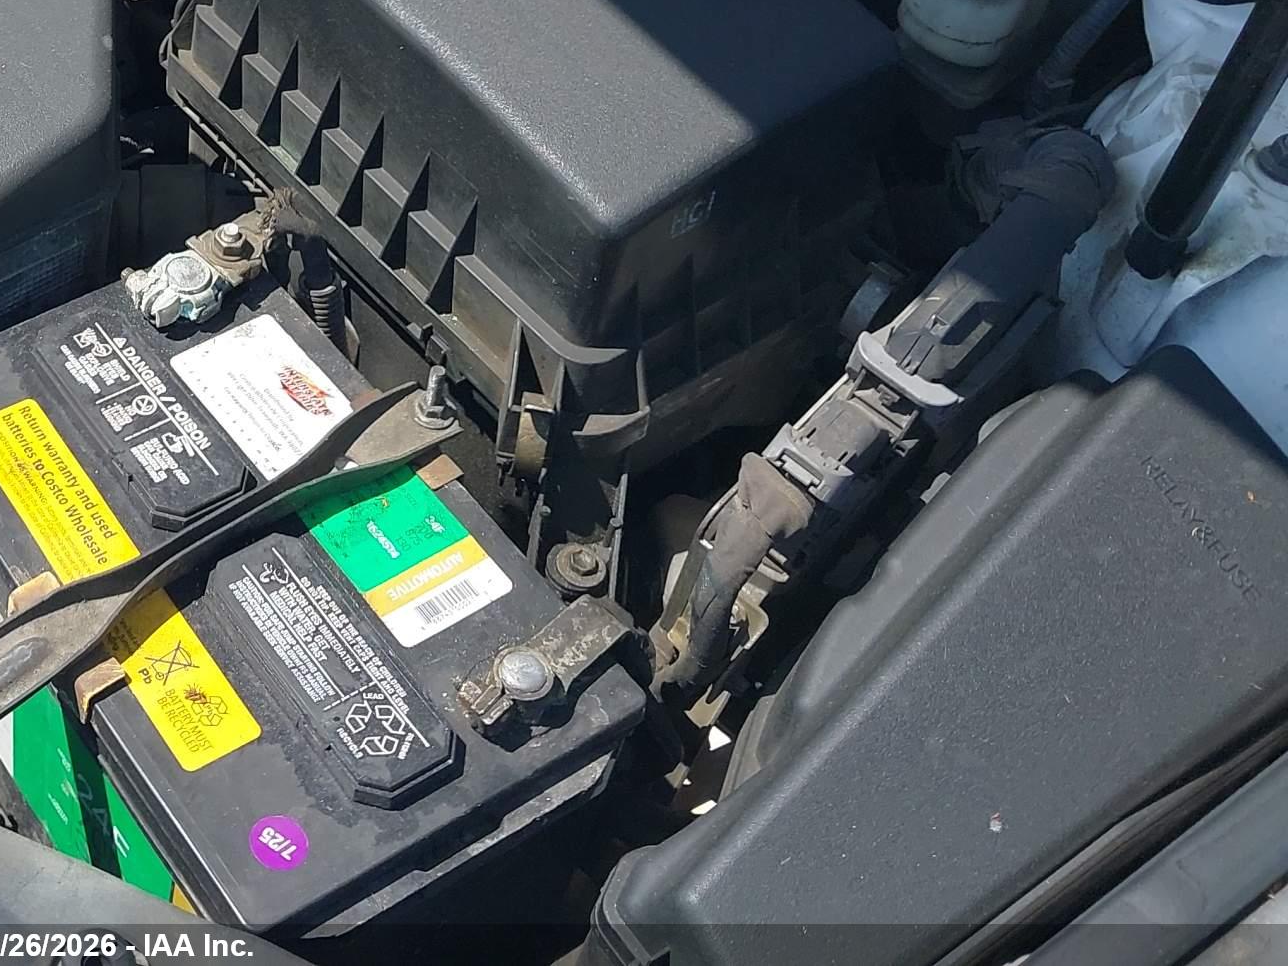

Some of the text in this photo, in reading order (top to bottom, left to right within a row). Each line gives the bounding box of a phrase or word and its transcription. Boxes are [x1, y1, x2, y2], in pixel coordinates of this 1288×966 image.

[122, 344, 167, 396] DANGER
[168, 401, 211, 451] POISON
[1, 411, 39, 459] batteries
[32, 457, 47, 472] to
[40, 468, 71, 506] Costco
[63, 504, 110, 566] Wholesale
[18, 404, 49, 442] Return
[40, 439, 80, 489] warranty
[73, 485, 97, 511] and
[89, 509, 117, 540] used
[385, 552, 465, 601] AUTOMOTIVE
[231, 588, 245, 603] NOT
[273, 643, 294, 669] SERVICE
[260, 601, 273, 616] FOR
[269, 613, 285, 631] SAFE
[292, 643, 317, 674] STARTING
[312, 670, 336, 697] FOLLOW
[268, 590, 328, 664] MEDICAL HELP FAST
[277, 585, 298, 609] WITH
[313, 633, 331, 652] GET
[285, 581, 361, 675] FLUSH EYES IMMEDIATELY
[316, 584, 407, 698] KEEP OUT OF THE REACH OF CHILDREN
[137, 666, 155, 686] Pb
[327, 611, 343, 629] KEEP
[340, 627, 356, 645] VENT
[353, 644, 369, 662] CAPS
[380, 678, 395, 695] AND
[391, 692, 410, 714] LEVEL
[363, 691, 383, 699] LEAD
[156, 694, 200, 754] BE RECYCLED
[164, 687, 213, 753] BATTERY MUST
[335, 726, 364, 760] RECYCLE
[256, 825, 297, 860] 7/25
